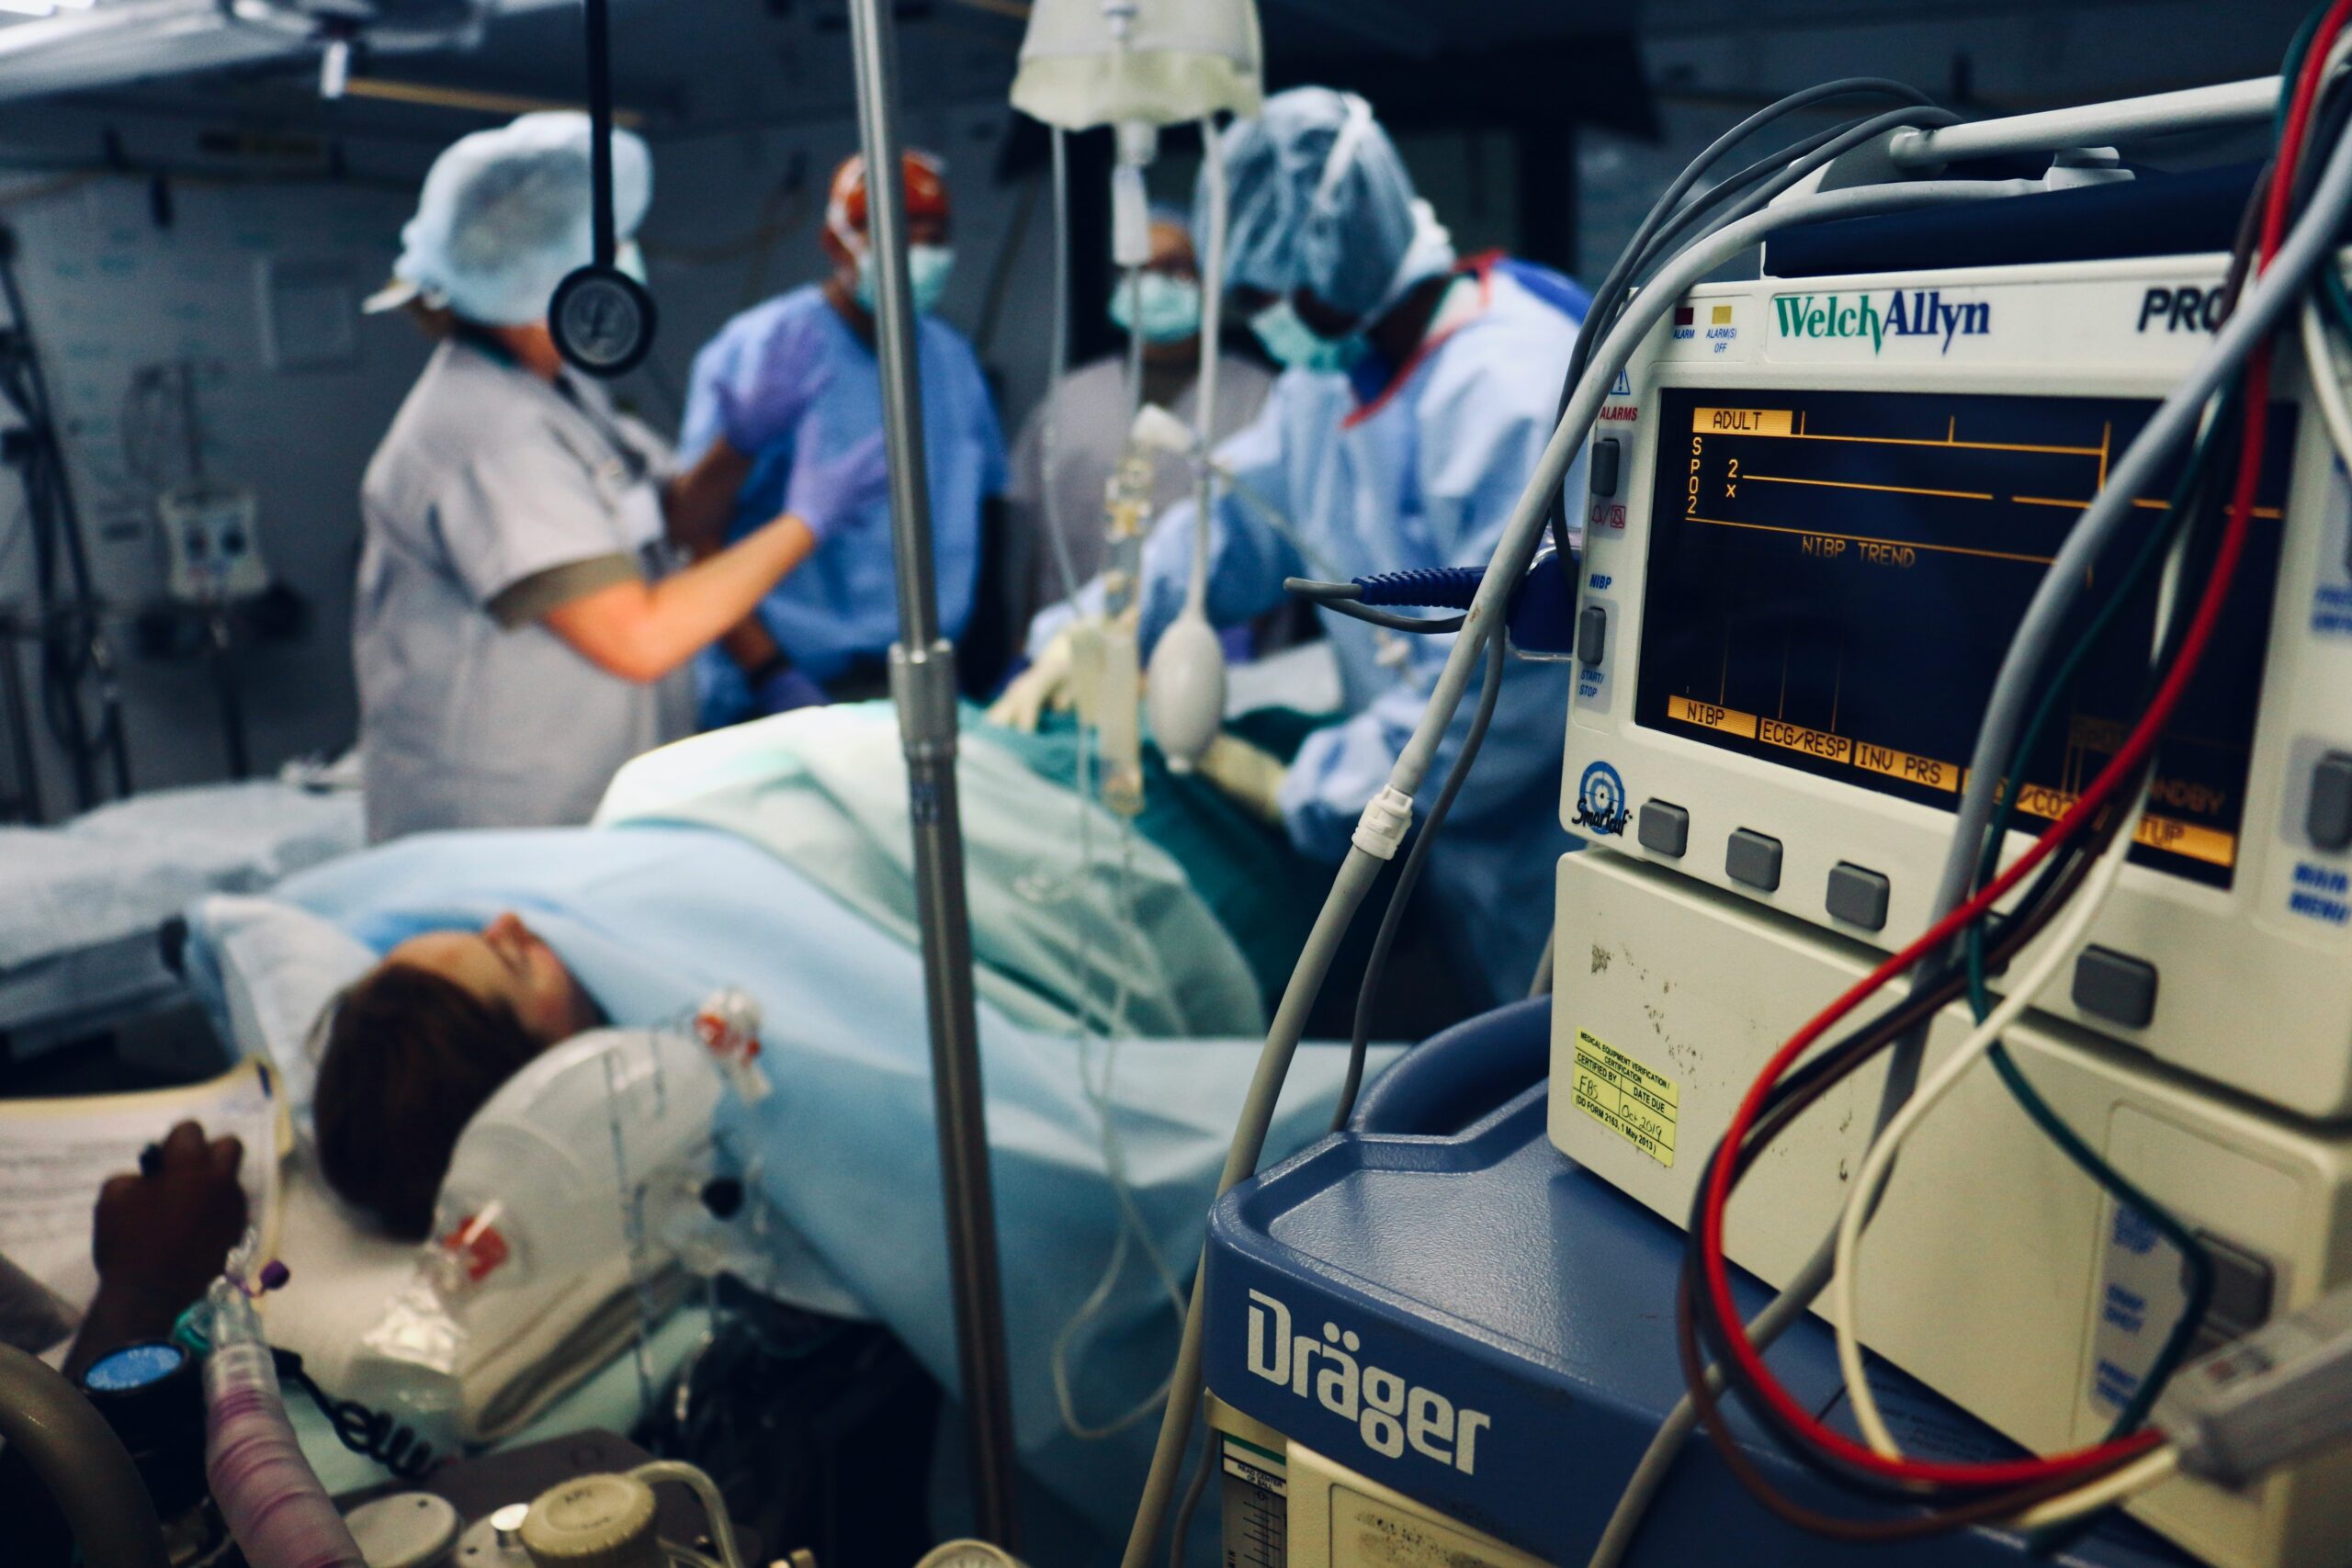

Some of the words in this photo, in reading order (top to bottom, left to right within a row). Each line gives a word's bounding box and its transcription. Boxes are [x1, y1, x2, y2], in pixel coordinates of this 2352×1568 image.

[1673, 329, 1695, 340] ALARM
[1706, 328, 1737, 340] ALARM(S)
[1714, 343, 1727, 354] OFF
[1600, 406, 1638, 422] ALARMS
[1713, 411, 1762, 431] ADULT
[1802, 536, 1846, 559] NIBP
[1858, 541, 1916, 569] TREND
[1589, 573, 1612, 590] NIBP
[1580, 669, 1605, 684] START/
[1579, 684, 1598, 698] STOP
[1687, 701, 1724, 727] NIBP
[1763, 721, 1848, 758] ECG/RESP
[1860, 745, 1894, 770] INV
[1905, 757, 1942, 784] PRS
[1577, 1053, 1607, 1077] CERTIFIED
[1608, 1073, 1617, 1083] BY
[1580, 1031, 1600, 1050] MEDICAL
[1602, 1044, 1631, 1066] EQUIPMENT
[1632, 1062, 1667, 1088] VERIFICATION
[1604, 1055, 1642, 1084] CERTIFICATION
[1633, 1087, 1651, 1104] DATE
[1651, 1098, 1666, 1113] DUE
[1587, 1101, 1604, 1119] FORM
[1625, 1126, 1638, 1143] May
[1248, 1288, 1491, 1475] Dräger
